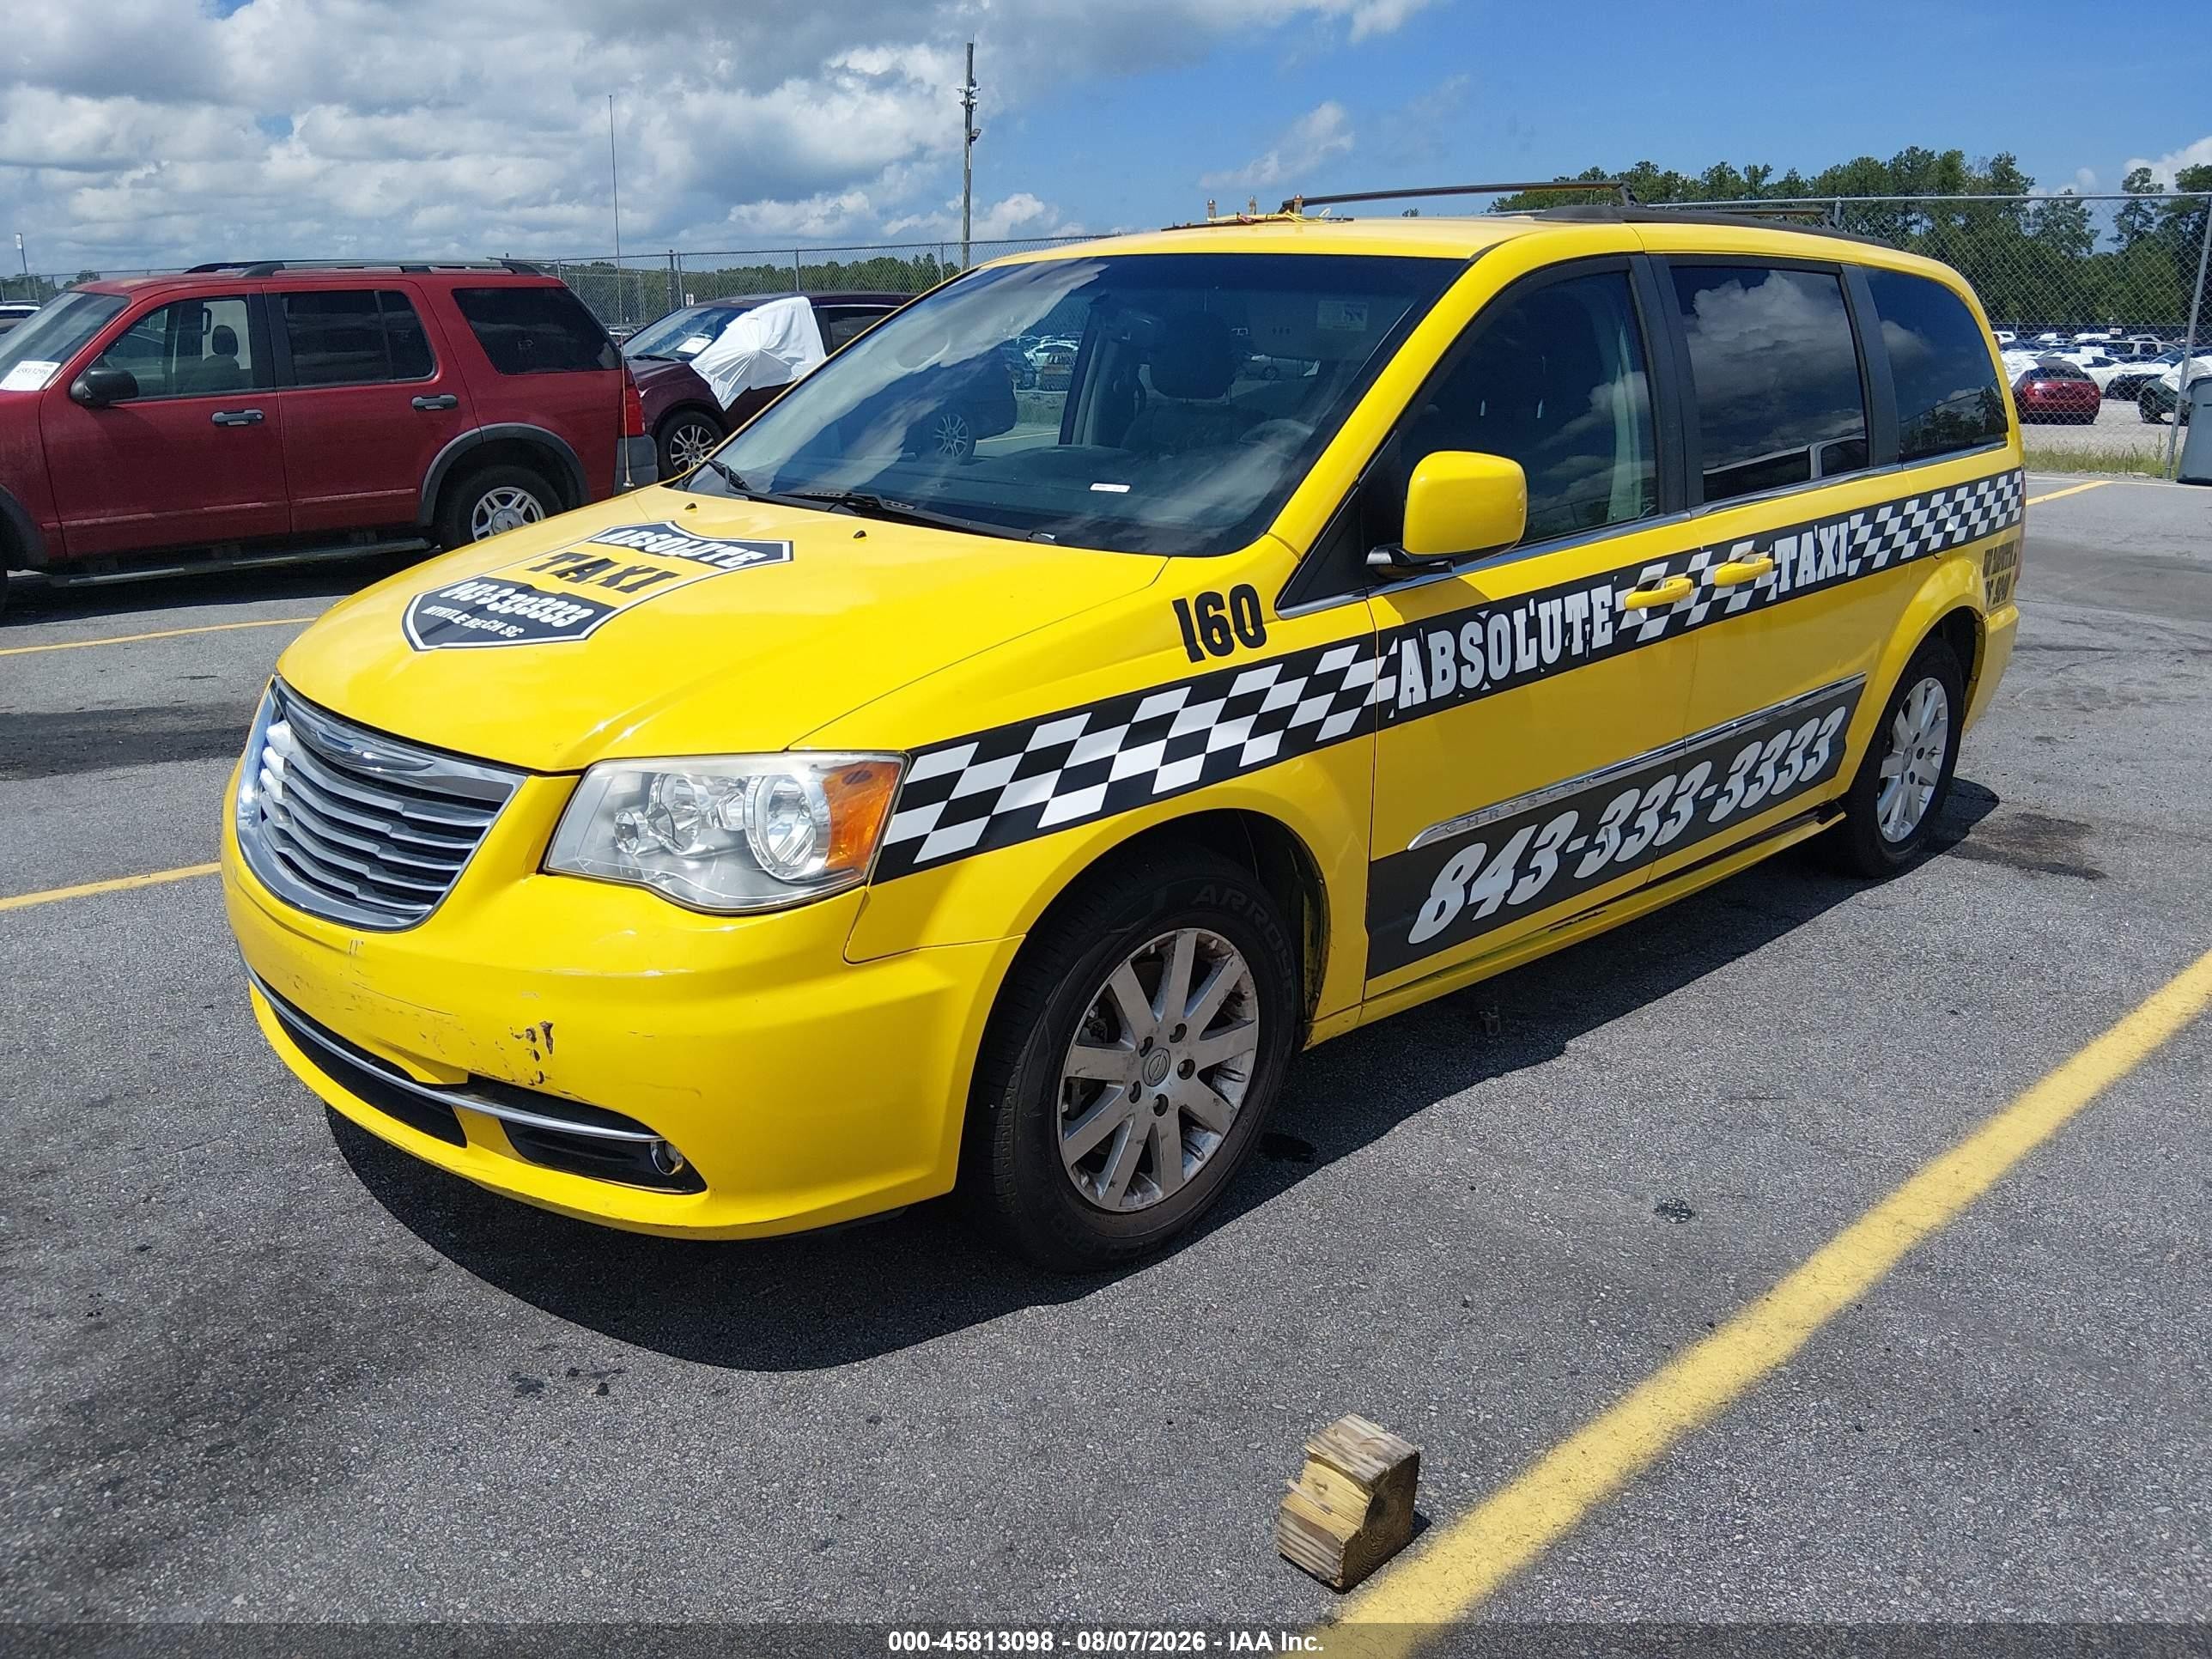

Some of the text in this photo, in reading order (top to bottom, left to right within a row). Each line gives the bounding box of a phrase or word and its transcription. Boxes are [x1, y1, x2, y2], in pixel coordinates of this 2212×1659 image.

[526, 552, 683, 593] TAXI
[594, 529, 768, 568] ABSOLUTE
[499, 625, 525, 638] SC
[1172, 584, 1268, 663] 160
[1398, 522, 1850, 709] ABSOLUTE TAXI
[1407, 706, 1846, 945] 843-333-3333
